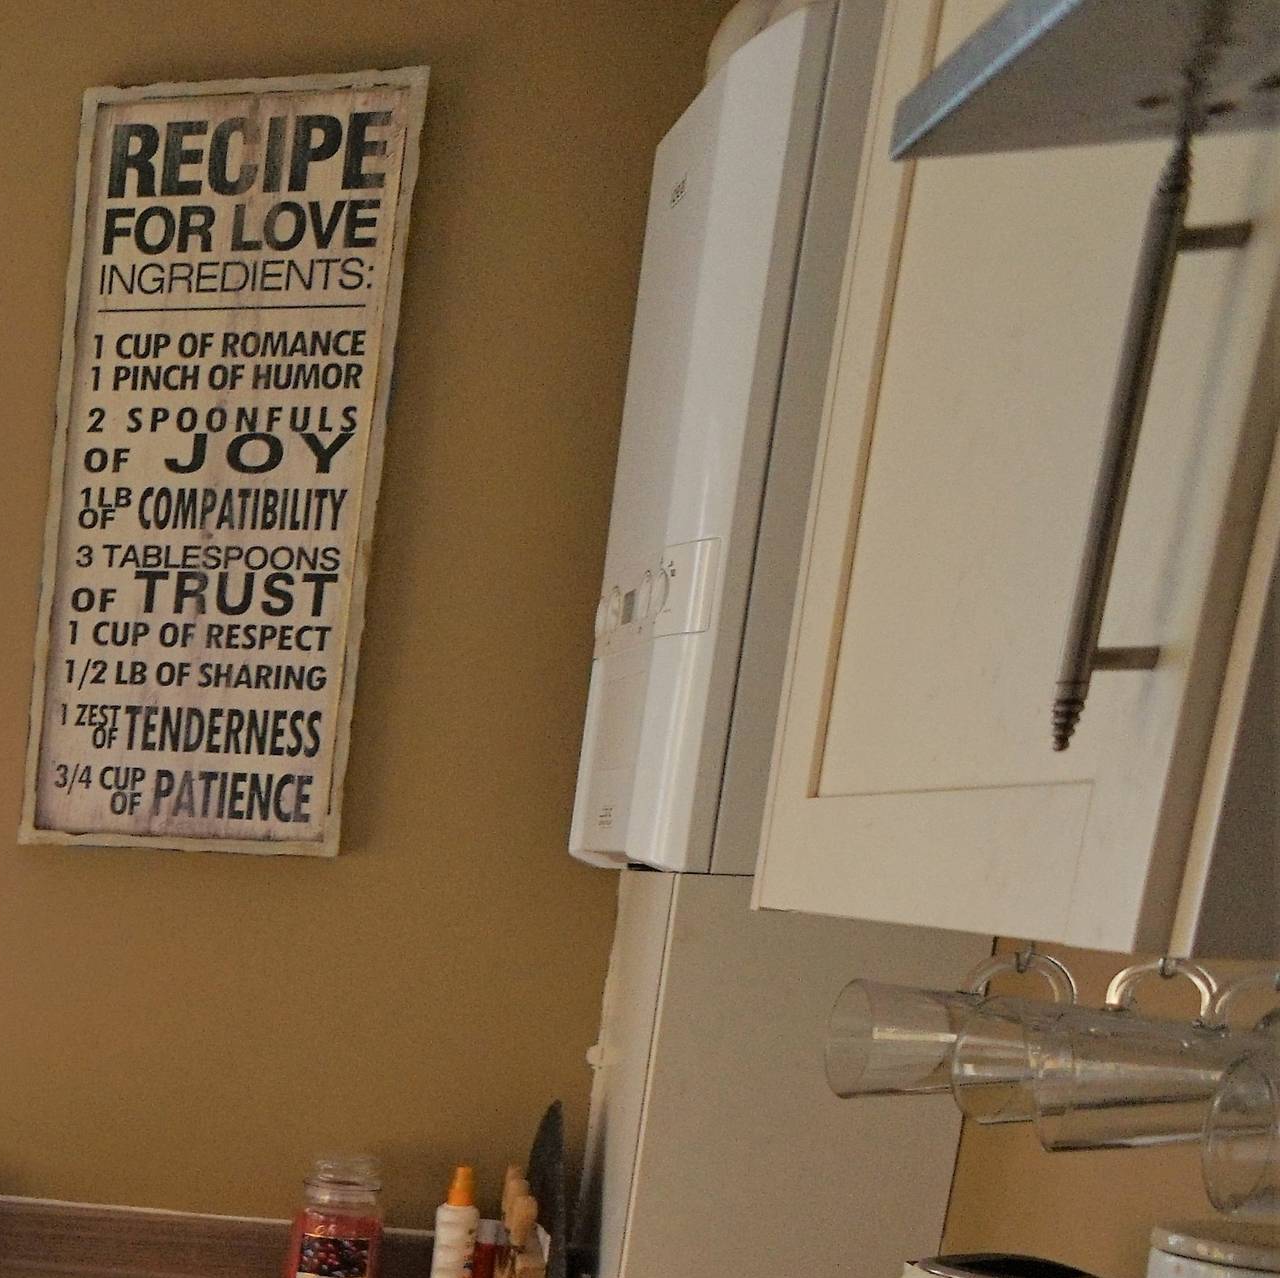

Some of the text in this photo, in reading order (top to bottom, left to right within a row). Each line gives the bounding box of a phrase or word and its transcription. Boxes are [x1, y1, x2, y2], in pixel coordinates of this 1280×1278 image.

[107, 110, 393, 199] RECIPE
[102, 199, 381, 255] FOR LOVE
[99, 257, 374, 295] INGREDIENTS:
[93, 330, 366, 359] 1 CUP OF ROMANCE
[90, 363, 362, 391] 1 PINCH OF HUMOR
[87, 406, 357, 433] 2 SPOONFULS
[84, 433, 355, 474] OF JOY
[78, 488, 348, 531] OF COMPATIBILITY
[75, 544, 341, 571] 3 TABLESPOONS
[71, 571, 338, 617] OF TRUST
[68, 621, 332, 651] 1 CUP OF RESPECT
[65, 659, 327, 691] 1/2 LB OF SHARING
[74, 704, 121, 727] ZEST
[92, 705, 322, 758] OF TENDERNESS
[54, 765, 146, 795] 3/4 CUP
[110, 769, 313, 823] OF PATIENCE
